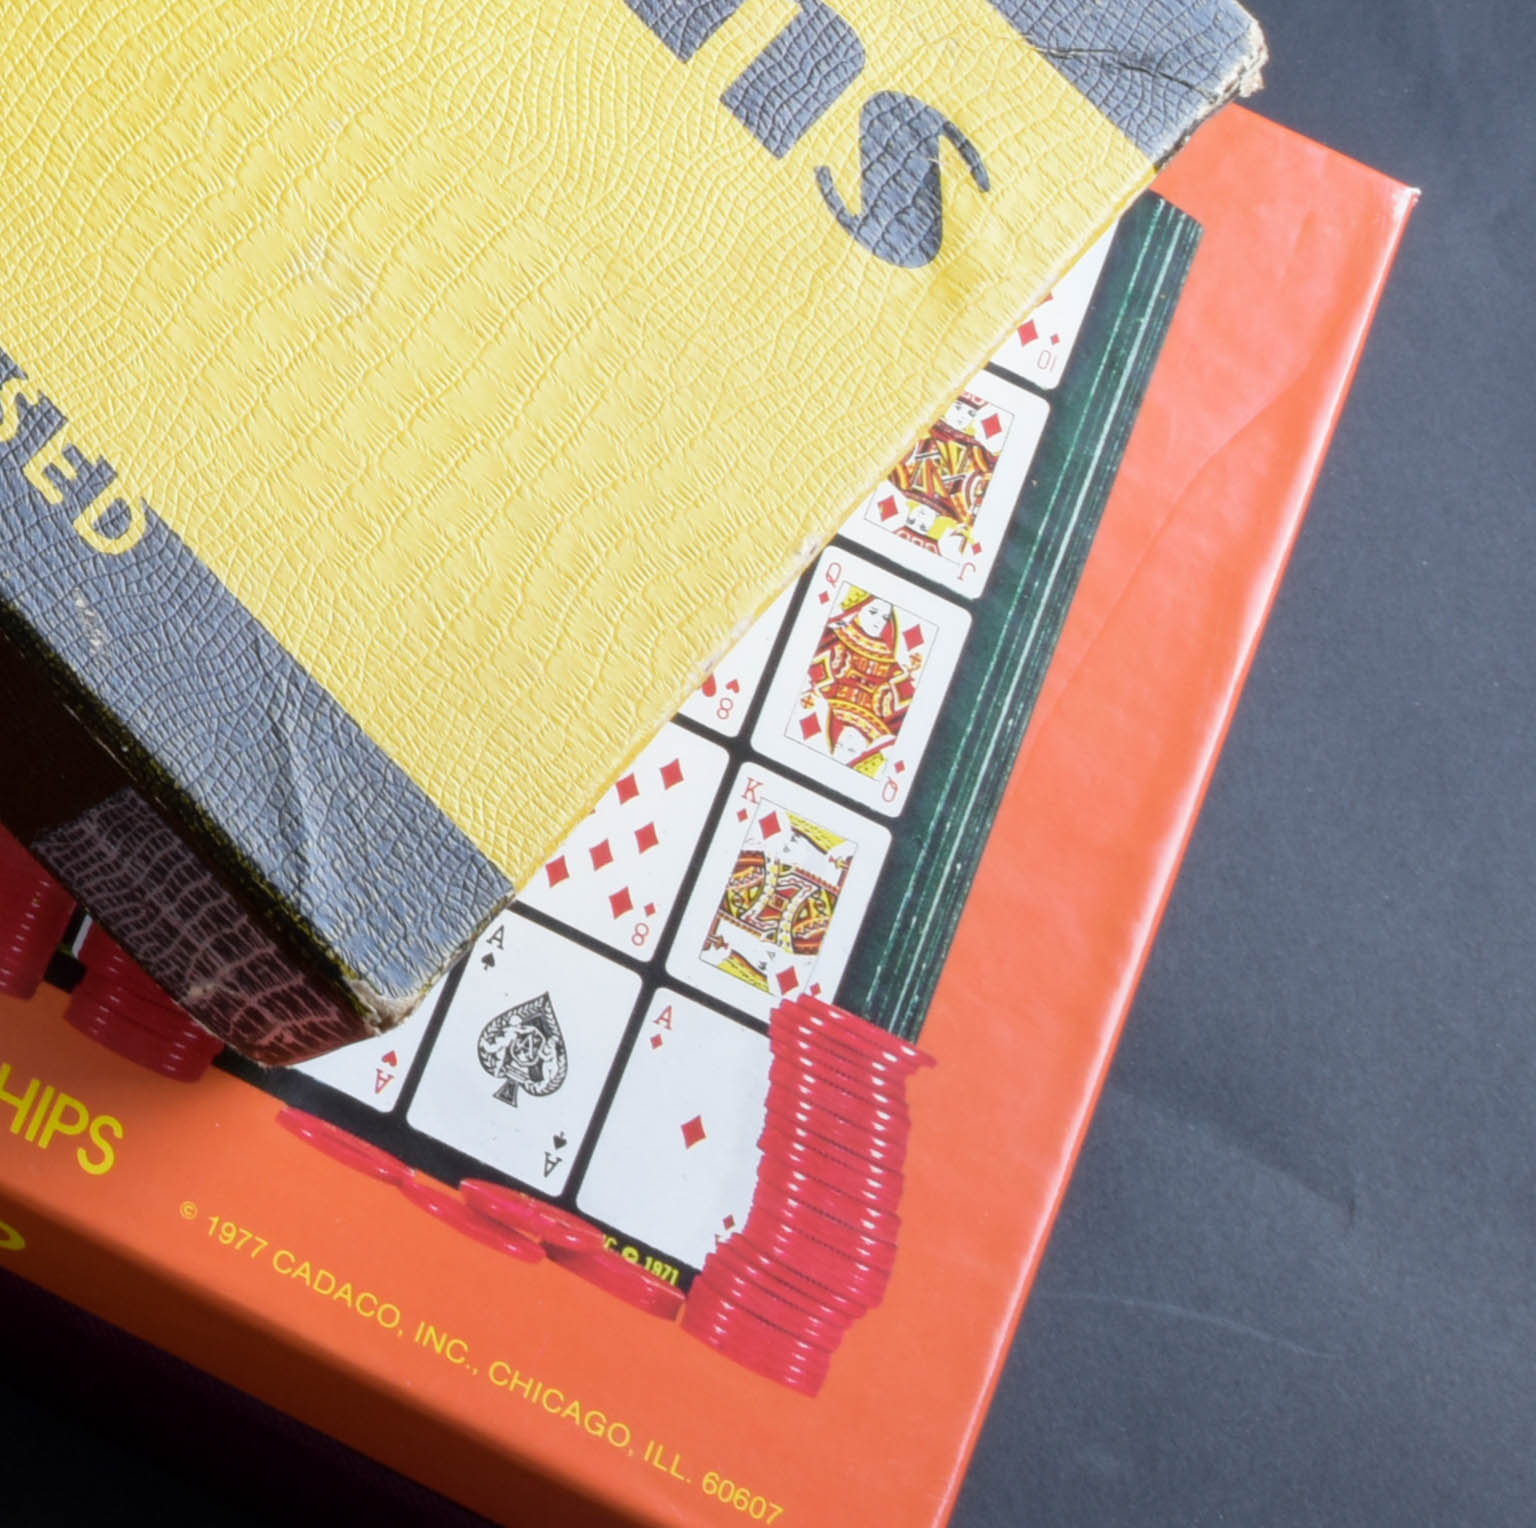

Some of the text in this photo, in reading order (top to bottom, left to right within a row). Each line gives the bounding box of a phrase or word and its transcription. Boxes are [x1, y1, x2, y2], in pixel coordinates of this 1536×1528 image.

[206, 1214, 784, 1527] 1977 CADACO, INC., CHICAGO, ILL. 60607
